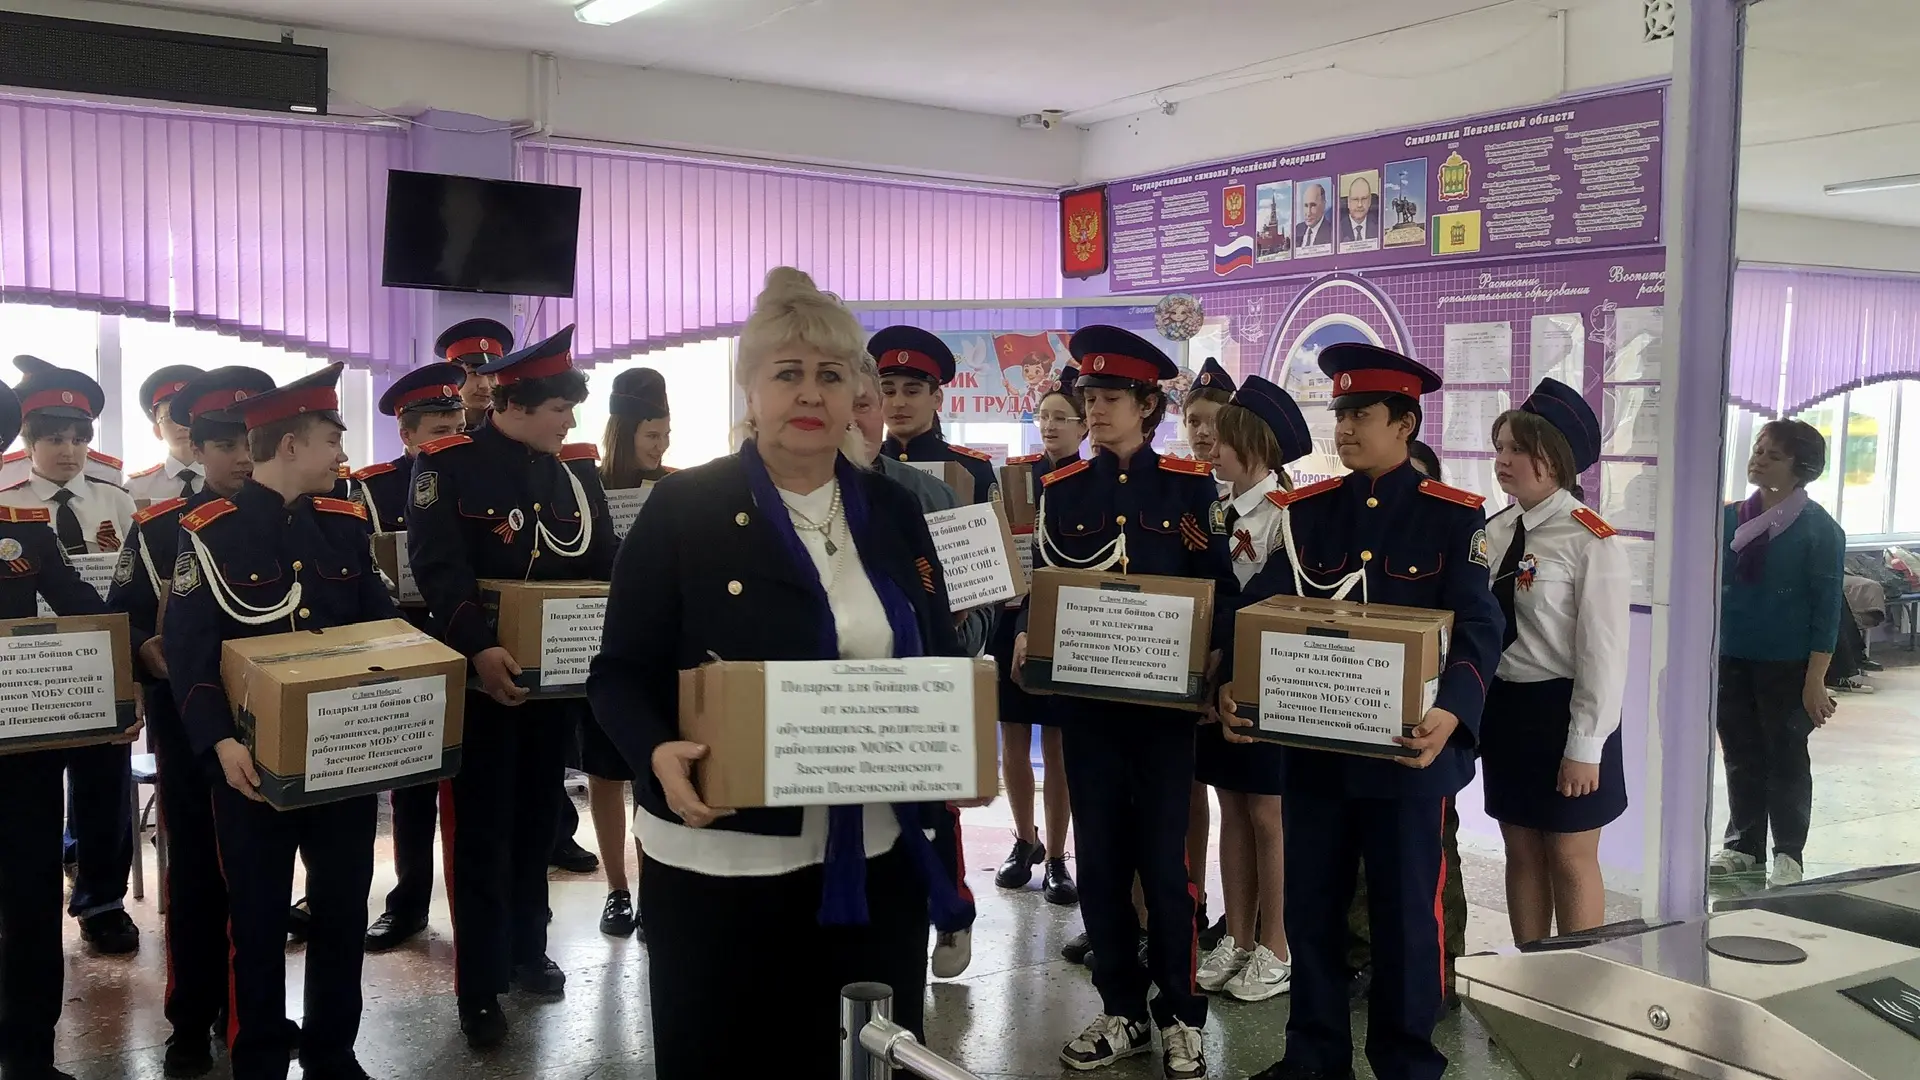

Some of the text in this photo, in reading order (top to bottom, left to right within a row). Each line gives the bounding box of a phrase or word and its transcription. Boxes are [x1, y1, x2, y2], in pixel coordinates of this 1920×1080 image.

[1405, 130, 1460, 146] Символика
[1463, 117, 1525, 138] Пензенской
[1529, 111, 1575, 126] области
[1132, 152, 1326, 192] Государственные символы Российской Федерации
[1479, 273, 1539, 289] Расписание
[1609, 266, 1665, 282] Воспита
[1437, 283, 1590, 308] дополнительного образования
[1636, 280, 1665, 299] рабо
[952, 396, 1033, 415] И ТРУДА
[188, 515, 204, 526] КК
[940, 525, 967, 535] бойцов
[968, 518, 987, 528] СВО
[951, 549, 989, 564] родителей
[944, 565, 969, 577] МОБУ
[971, 560, 992, 571] СОШ
[948, 575, 994, 592] Пензенского
[949, 585, 1007, 606] зенской области
[1067, 603, 1104, 613] Подарки
[1124, 608, 1155, 618] бойцов
[1158, 611, 1179, 620] СВО
[1102, 621, 1153, 631] коллектива
[1062, 628, 1124, 640] обучающихся,
[1126, 636, 1171, 645] родителей
[39, 650, 73, 659] бойцов
[76, 648, 98, 656] СВО
[546, 647, 587, 655] работников
[1060, 640, 1110, 650] работников
[1113, 644, 1143, 653] МОБУ
[1145, 647, 1170, 656] СОШ
[1328, 643, 1355, 651] Победы!
[1071, 652, 1166, 668] Засечное Пензенского
[1270, 648, 1390, 668] Подарки для бойцов СВО
[16, 665, 73, 675] коллектива
[545, 669, 569, 677] района
[1057, 664, 1178, 682] района Пензенской области
[1308, 668, 1362, 679] коллектива
[45, 675, 93, 687] родителей
[781, 680, 954, 694] Подарки для бойцов СВО
[1266, 675, 1331, 689] обучающихся,
[1334, 683, 1381, 695] родителей
[31, 689, 64, 698] МОБУ
[67, 686, 94, 695] СОШ
[358, 691, 375, 699] Днем
[377, 687, 402, 697] Победы!
[1265, 687, 1318, 700] работников
[1320, 693, 1352, 703] МОБУ
[1354, 698, 1380, 708] СОШ
[1, 701, 92, 713] ечное Пензенского
[318, 693, 433, 716] Подарки для бойцов СВО
[821, 705, 919, 714] от коллектива
[1277, 701, 1378, 720] Засечное Пензенского
[9, 713, 66, 725] Пензенской
[69, 711, 106, 720] области
[357, 712, 410, 725] коллектива
[1264, 712, 1391, 734] района Пензенской области
[314, 730, 380, 742] обучающихся,
[383, 719, 426, 735] родителей
[777, 722, 959, 738] обучающихся, родителей и
[312, 743, 367, 756] работников
[370, 736, 399, 746] МОБУ
[402, 731, 425, 742] СОШ
[775, 741, 962, 758] работников МОБУ СОШ с.
[325, 745, 423, 765] Засечное Пензенского
[310, 754, 433, 781] района Пензенской области
[795, 761, 943, 775] Засечное Пензенского
[773, 780, 962, 797] района Пензенской области
